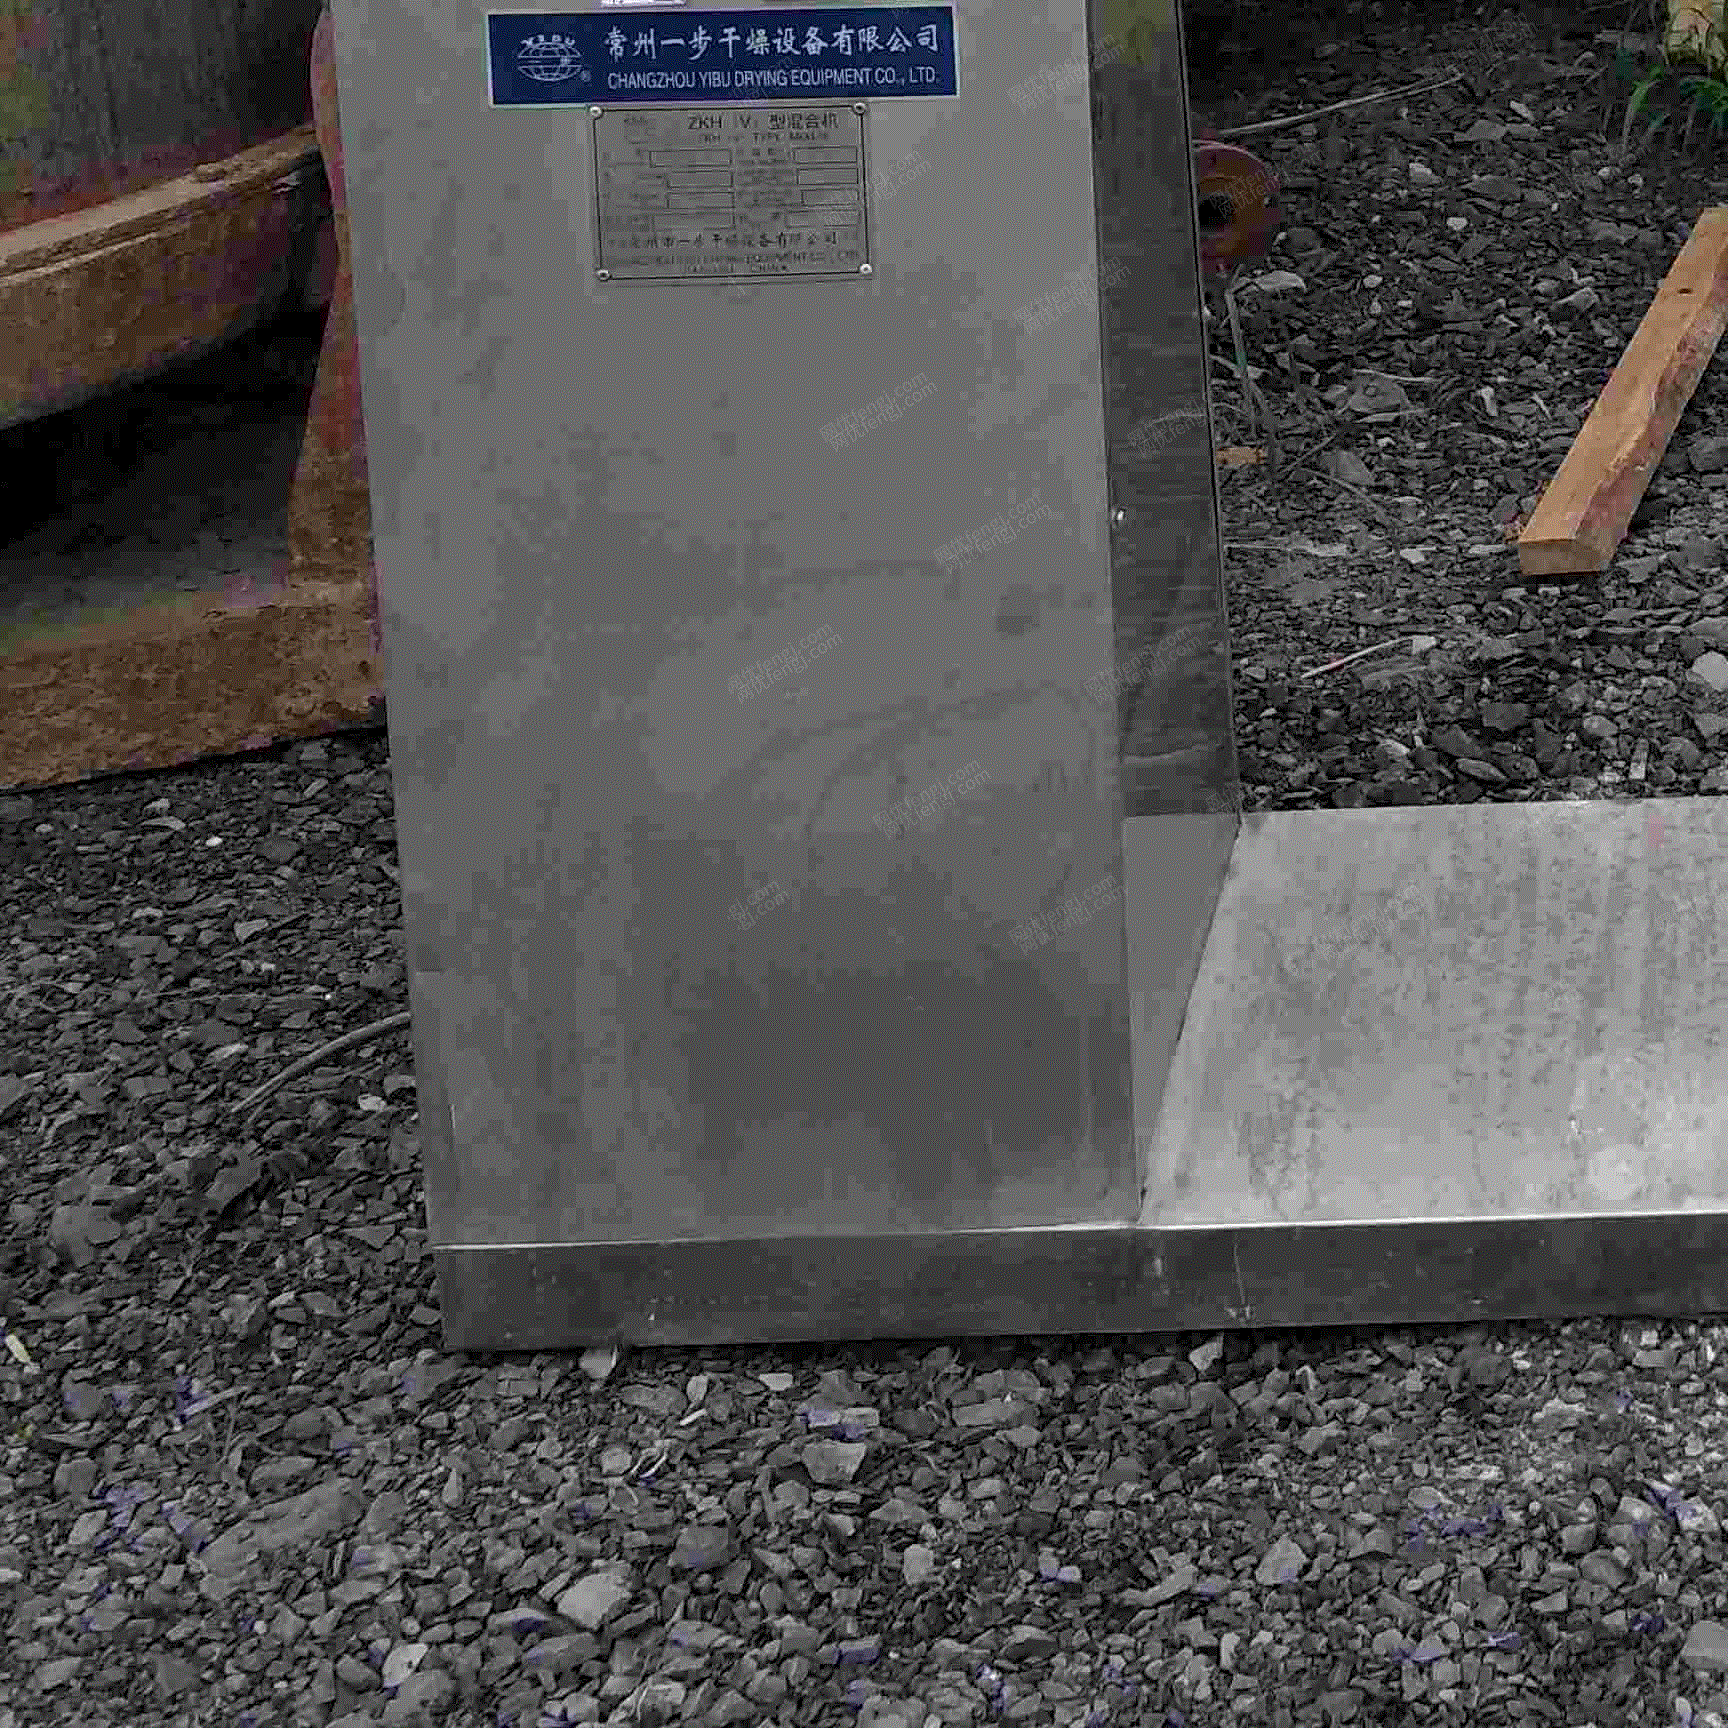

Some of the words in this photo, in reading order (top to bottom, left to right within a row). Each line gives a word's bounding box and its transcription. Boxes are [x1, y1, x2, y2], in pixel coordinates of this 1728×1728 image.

[604, 24, 938, 60] 常州一步干燥设备有限公司
[607, 70, 696, 89] CHANGZHOU
[697, 70, 731, 88] YIBU
[733, 69, 788, 87] DRYING
[790, 68, 873, 86] EQUIPMENT
